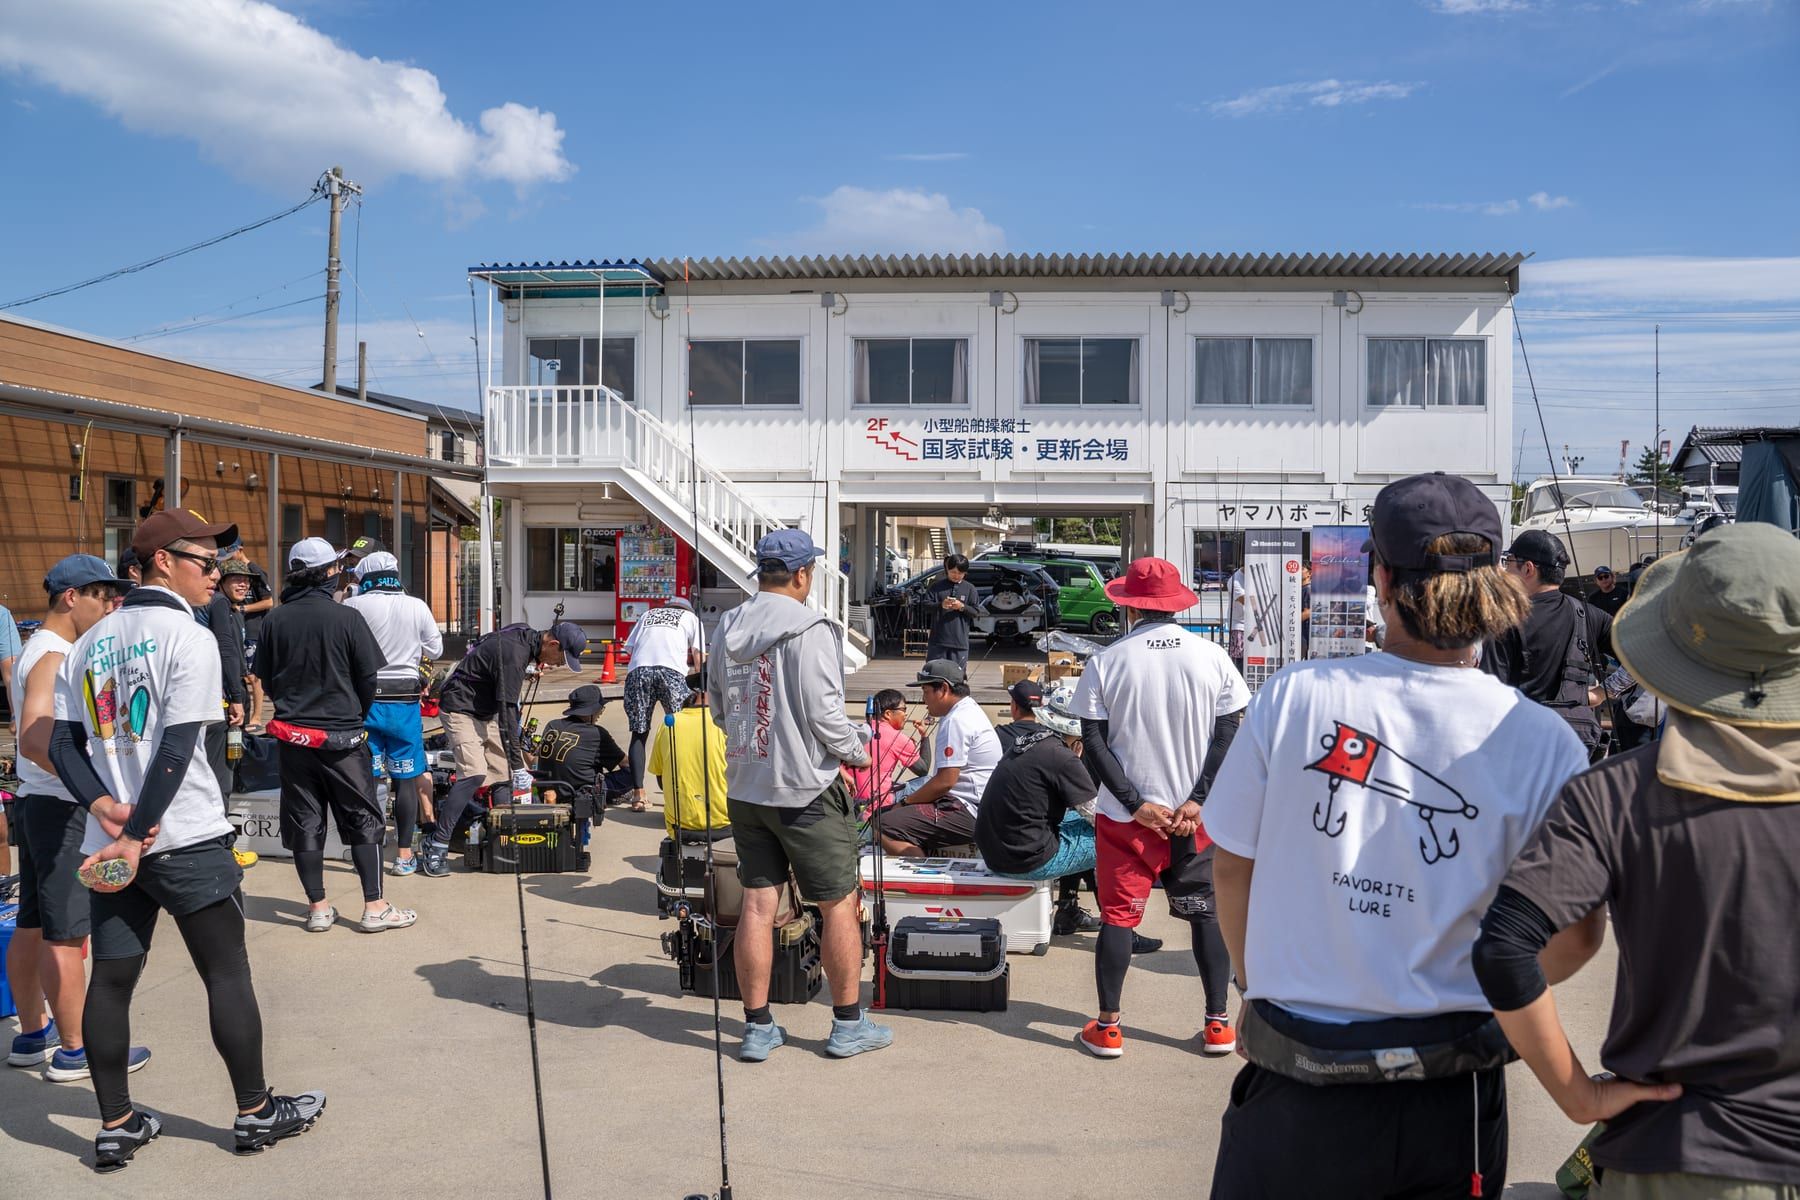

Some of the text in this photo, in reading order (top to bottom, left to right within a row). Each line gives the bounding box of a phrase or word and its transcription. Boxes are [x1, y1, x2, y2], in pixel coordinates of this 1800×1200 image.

[867, 418, 889, 431] 2F
[923, 418, 1032, 434] 小型船舶操縦士
[922, 438, 1129, 461] 国家試験・更新会場
[84, 635, 116, 665] JUST
[92, 638, 157, 677] CHILLING
[756, 654, 774, 759] JOURNEY
[540, 729, 580, 763] 87
[1333, 872, 1415, 903] FAVORITE
[1349, 897, 1392, 918] LURE
